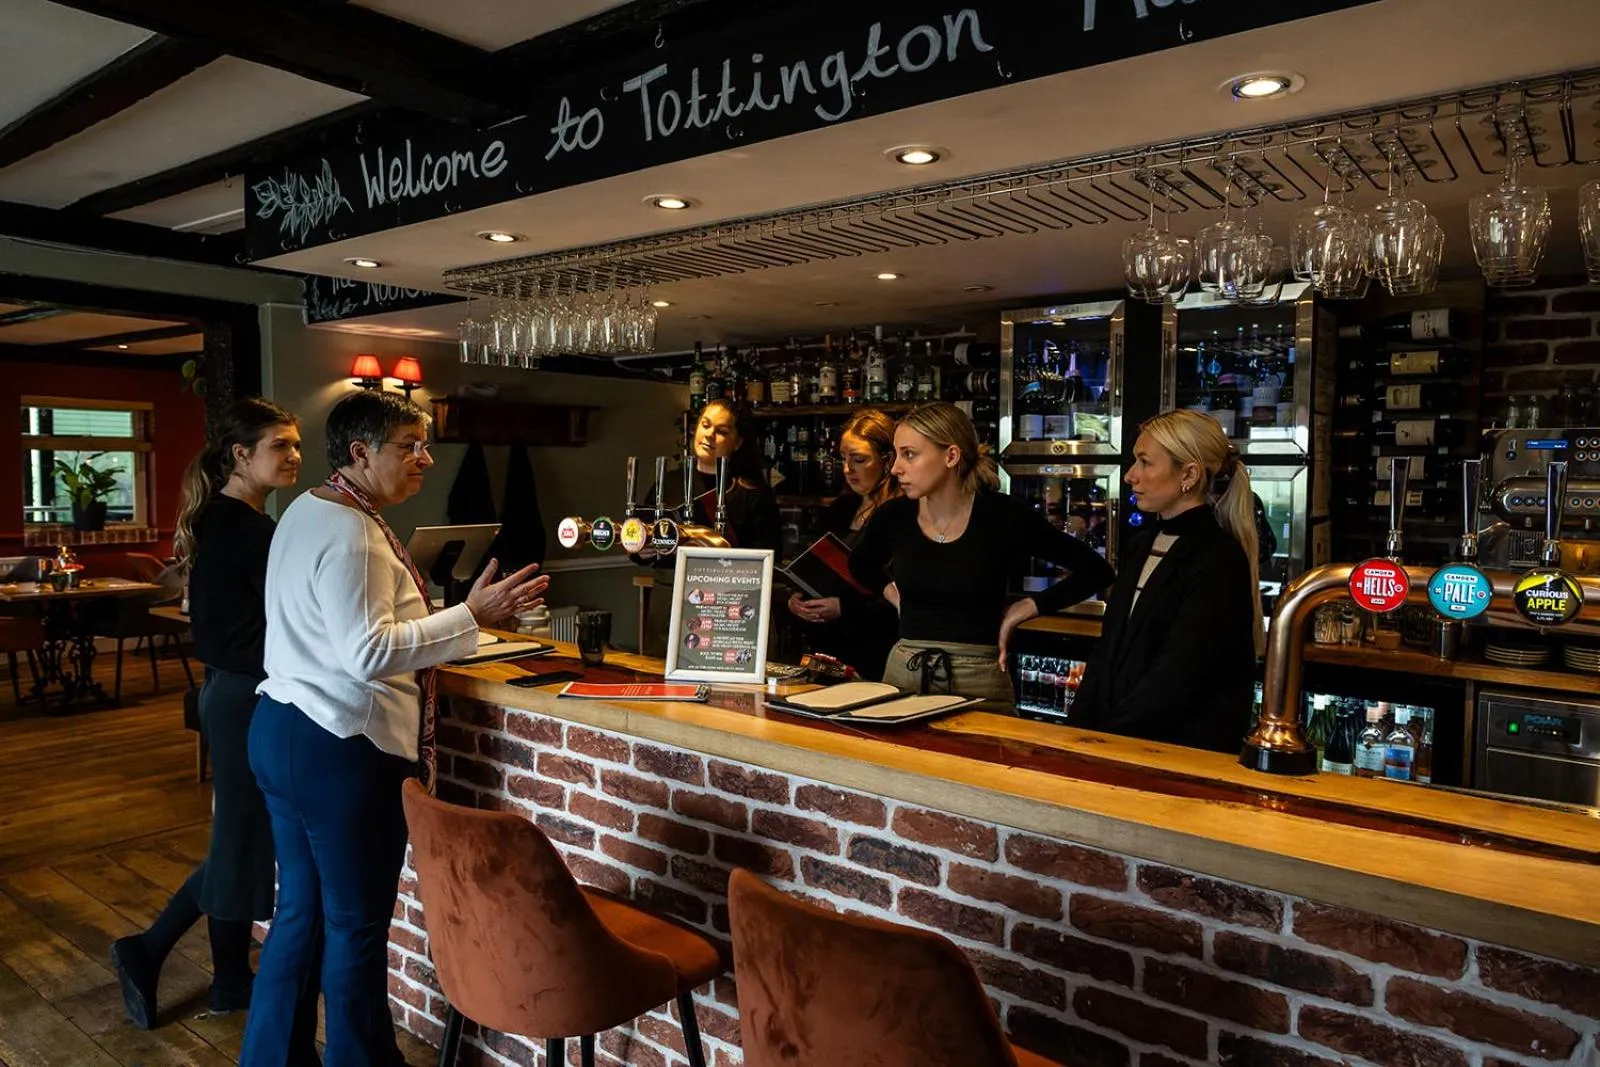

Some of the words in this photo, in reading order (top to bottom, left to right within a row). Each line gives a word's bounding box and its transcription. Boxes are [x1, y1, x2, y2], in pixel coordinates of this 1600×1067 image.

[359, 138, 509, 209] Welcome
[544, 96, 605, 162] to
[623, 8, 995, 142] Tottington
[687, 575, 730, 584] UPCOMING
[731, 576, 761, 585] EVENTS
[1366, 569, 1393, 577] CAMDEN
[1446, 574, 1475, 582] CAMDEN
[1363, 576, 1395, 598] HELLS
[1443, 582, 1476, 605] PALE
[1527, 597, 1567, 611] APPLE
